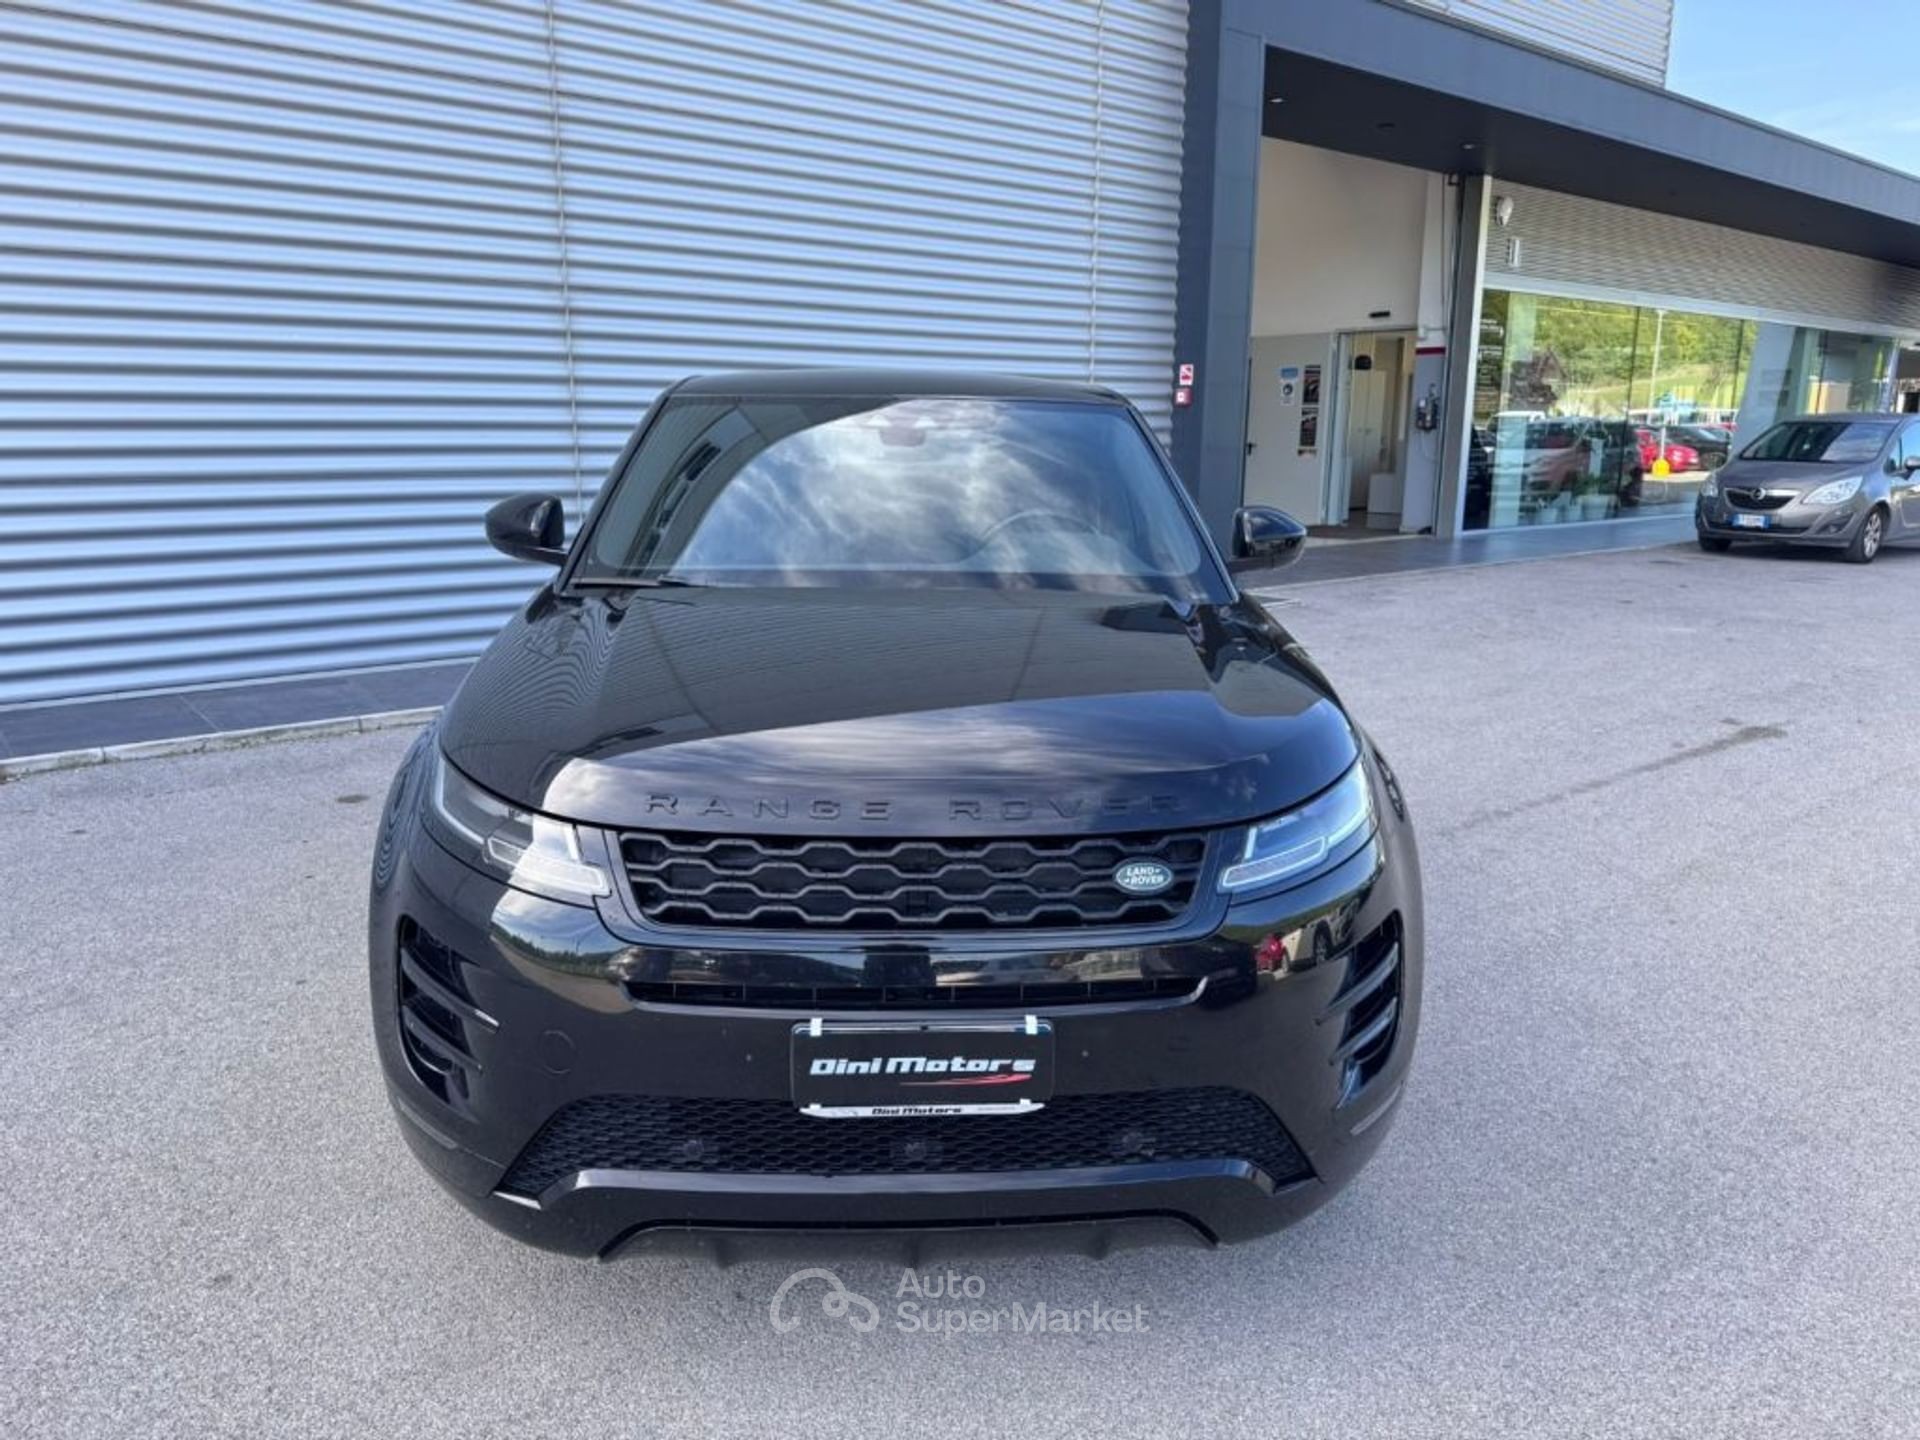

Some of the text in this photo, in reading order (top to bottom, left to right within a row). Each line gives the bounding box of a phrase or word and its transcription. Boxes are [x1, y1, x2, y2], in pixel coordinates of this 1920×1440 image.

[646, 793, 1178, 821] RANGE ROVER
[809, 1055, 1037, 1076] Dini Motors
[871, 1106, 962, 1116] Dini Motors
